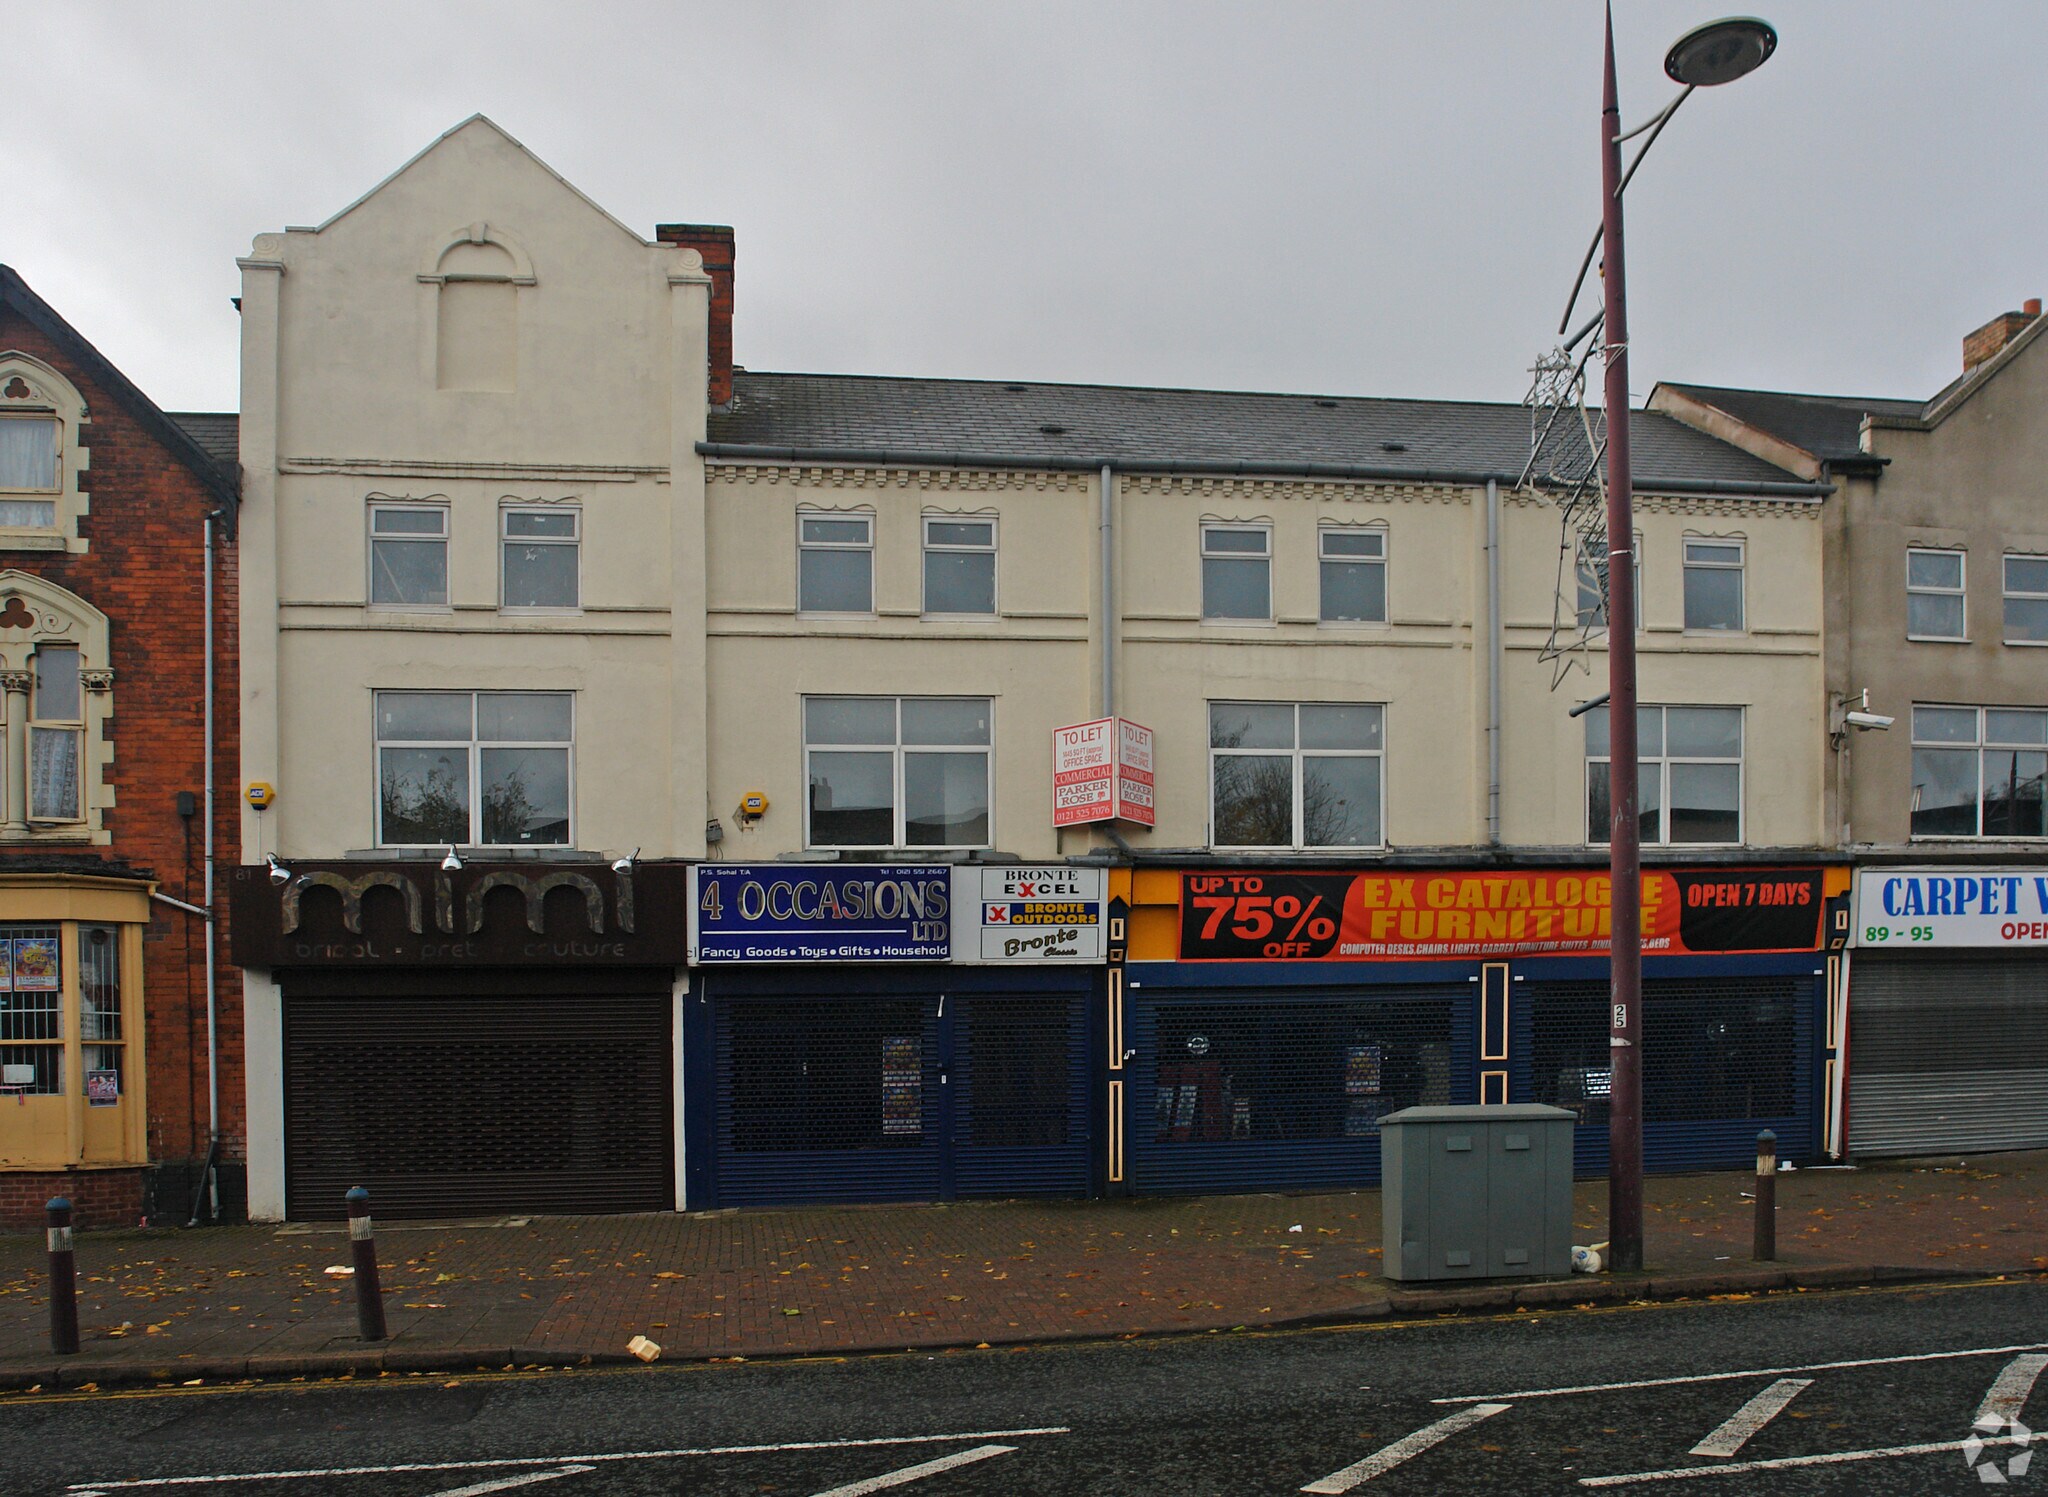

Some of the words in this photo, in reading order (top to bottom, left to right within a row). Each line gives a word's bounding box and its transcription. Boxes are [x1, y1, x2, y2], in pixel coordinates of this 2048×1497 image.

[1063, 731, 1078, 746] TO
[1081, 726, 1103, 743] LET
[1124, 726, 1134, 741] TO
[1135, 730, 1148, 746] LET
[1063, 757, 1084, 769] OFFICE
[1084, 753, 1103, 765] SPACE
[1055, 767, 1112, 785] COMMERCIAL
[1058, 780, 1108, 797] PARKER
[1122, 780, 1152, 796] PARKER
[1061, 792, 1094, 806] ROSE
[1124, 791, 1144, 804] ROSE
[1056, 810, 1074, 821] 0121
[1075, 807, 1090, 819] 525
[235, 869, 252, 881] 81
[1005, 870, 1078, 881] BRONTE
[1004, 882, 1080, 898] EXCEL
[1190, 877, 1225, 893] UP
[1227, 876, 1263, 893] TO
[1364, 878, 1415, 908] EX
[1426, 876, 1663, 908] CATALOGE
[701, 880, 724, 920] 4
[737, 880, 948, 920] OCCASIONS
[1687, 883, 1741, 907] OPEN
[1745, 883, 1755, 907] 7
[1759, 882, 1811, 907] DAYS
[1883, 877, 2022, 917] CARPET
[281, 871, 635, 935] mimi
[1024, 903, 1085, 913] BRONTE
[1012, 914, 1097, 924] OUTDOORS
[1192, 895, 1336, 941] 75%
[1370, 906, 1656, 940] FURNITUE
[911, 921, 948, 942] LTD
[1865, 926, 1889, 942] 89
[1910, 926, 1934, 941] 95
[1004, 928, 1078, 957] Bronte
[1263, 942, 1312, 958] OFF
[1340, 943, 1386, 955] COMPUTER
[701, 947, 741, 959] Fancy
[746, 946, 788, 958] Goods
[798, 946, 828, 958] Toys
[838, 945, 872, 957] Gifts
[882, 945, 948, 957] Household
